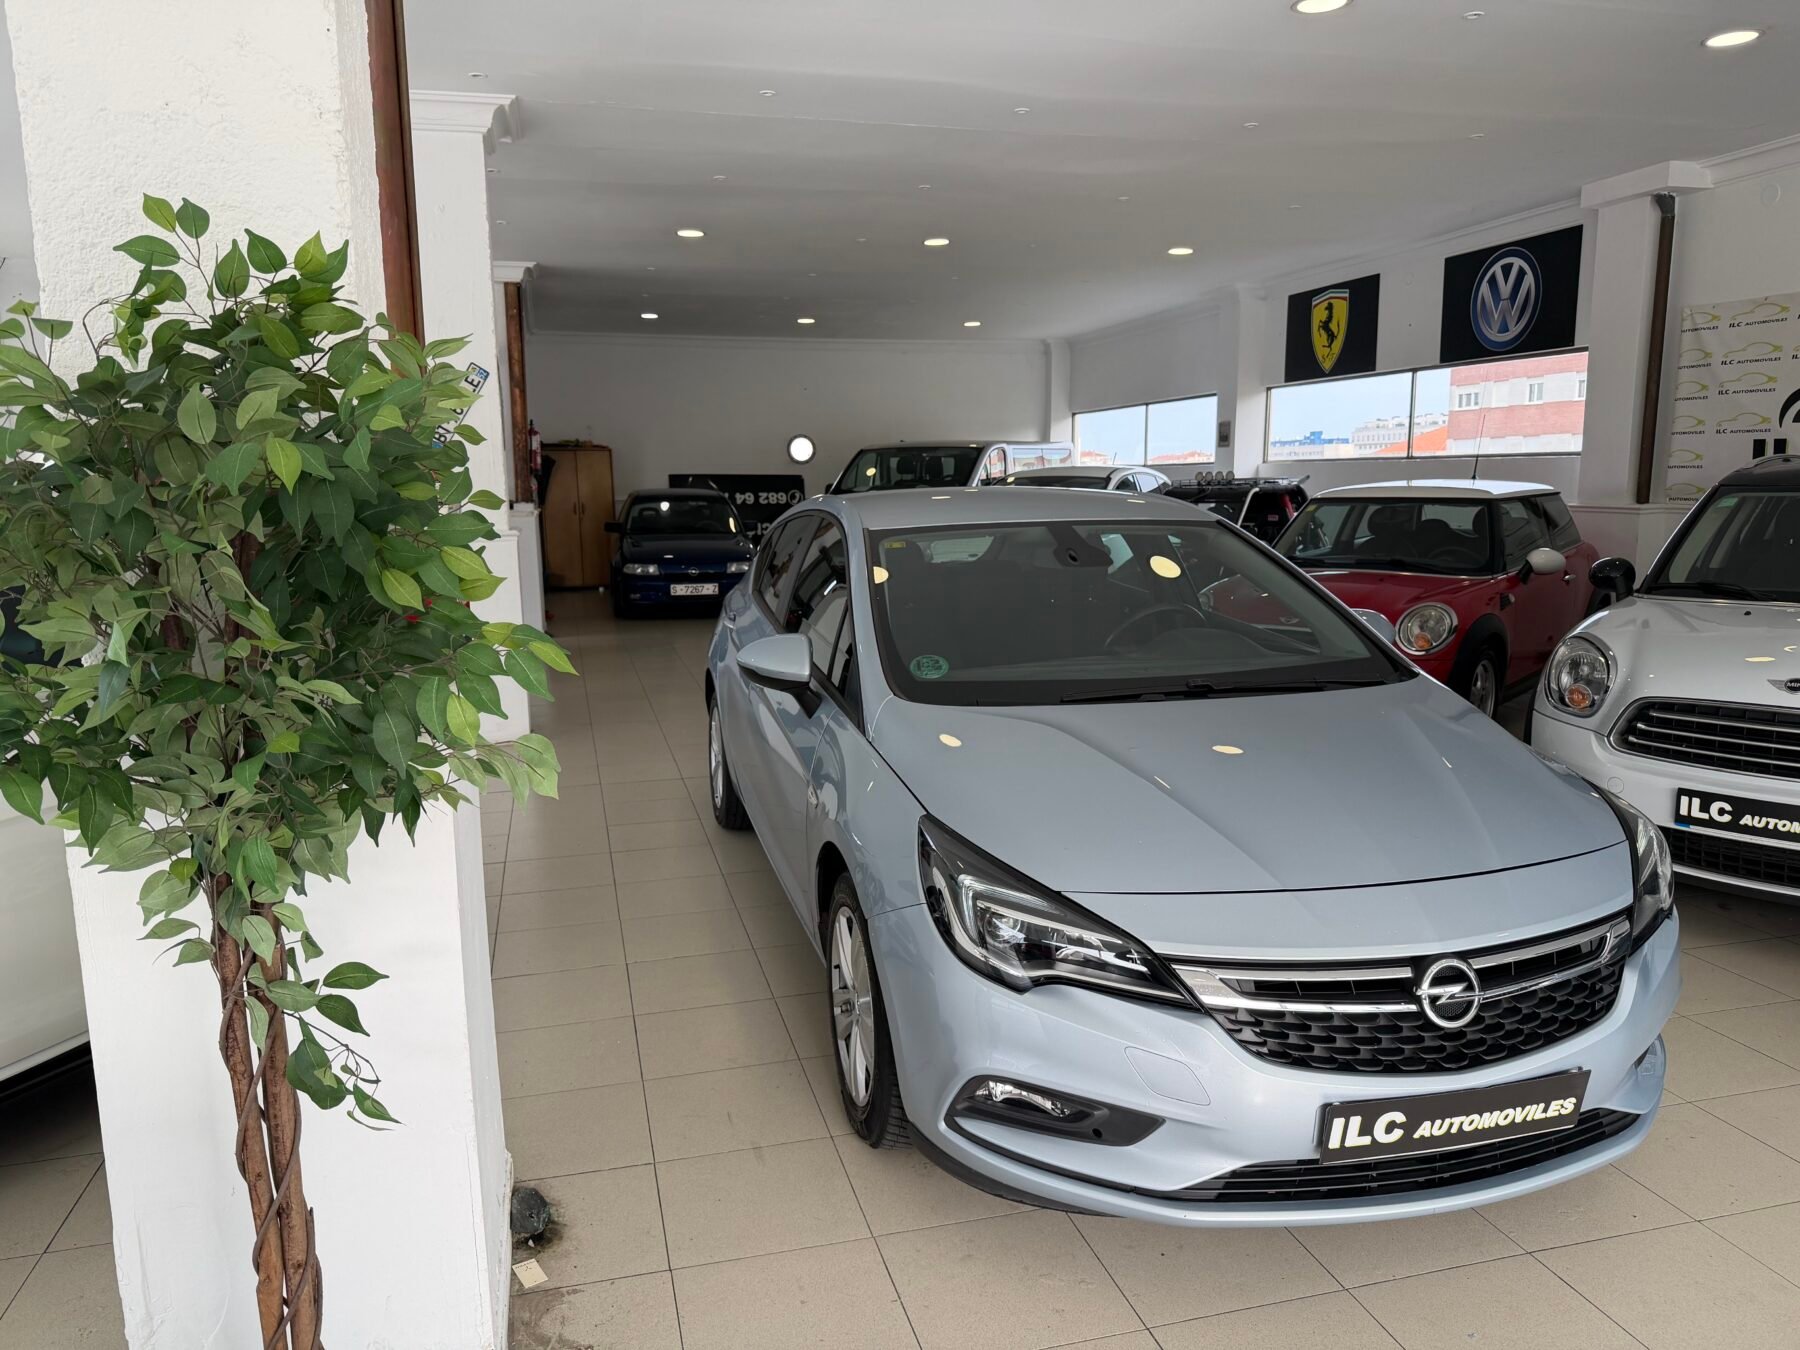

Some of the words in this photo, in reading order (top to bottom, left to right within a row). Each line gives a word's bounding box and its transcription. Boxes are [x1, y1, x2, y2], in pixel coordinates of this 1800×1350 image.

[1729, 321, 1743, 329] ILC
[1744, 317, 1788, 327] AUTOMOVILES
[1736, 356, 1781, 364] AUTOMOVILES
[1731, 387, 1776, 395] AUTOMOVILES
[734, 492, 754, 504] 64
[758, 492, 787, 504] 682
[1679, 795, 1733, 823] ILC
[1328, 1111, 1407, 1150] ILC
[1412, 1097, 1577, 1139] AUTOMOVILES
